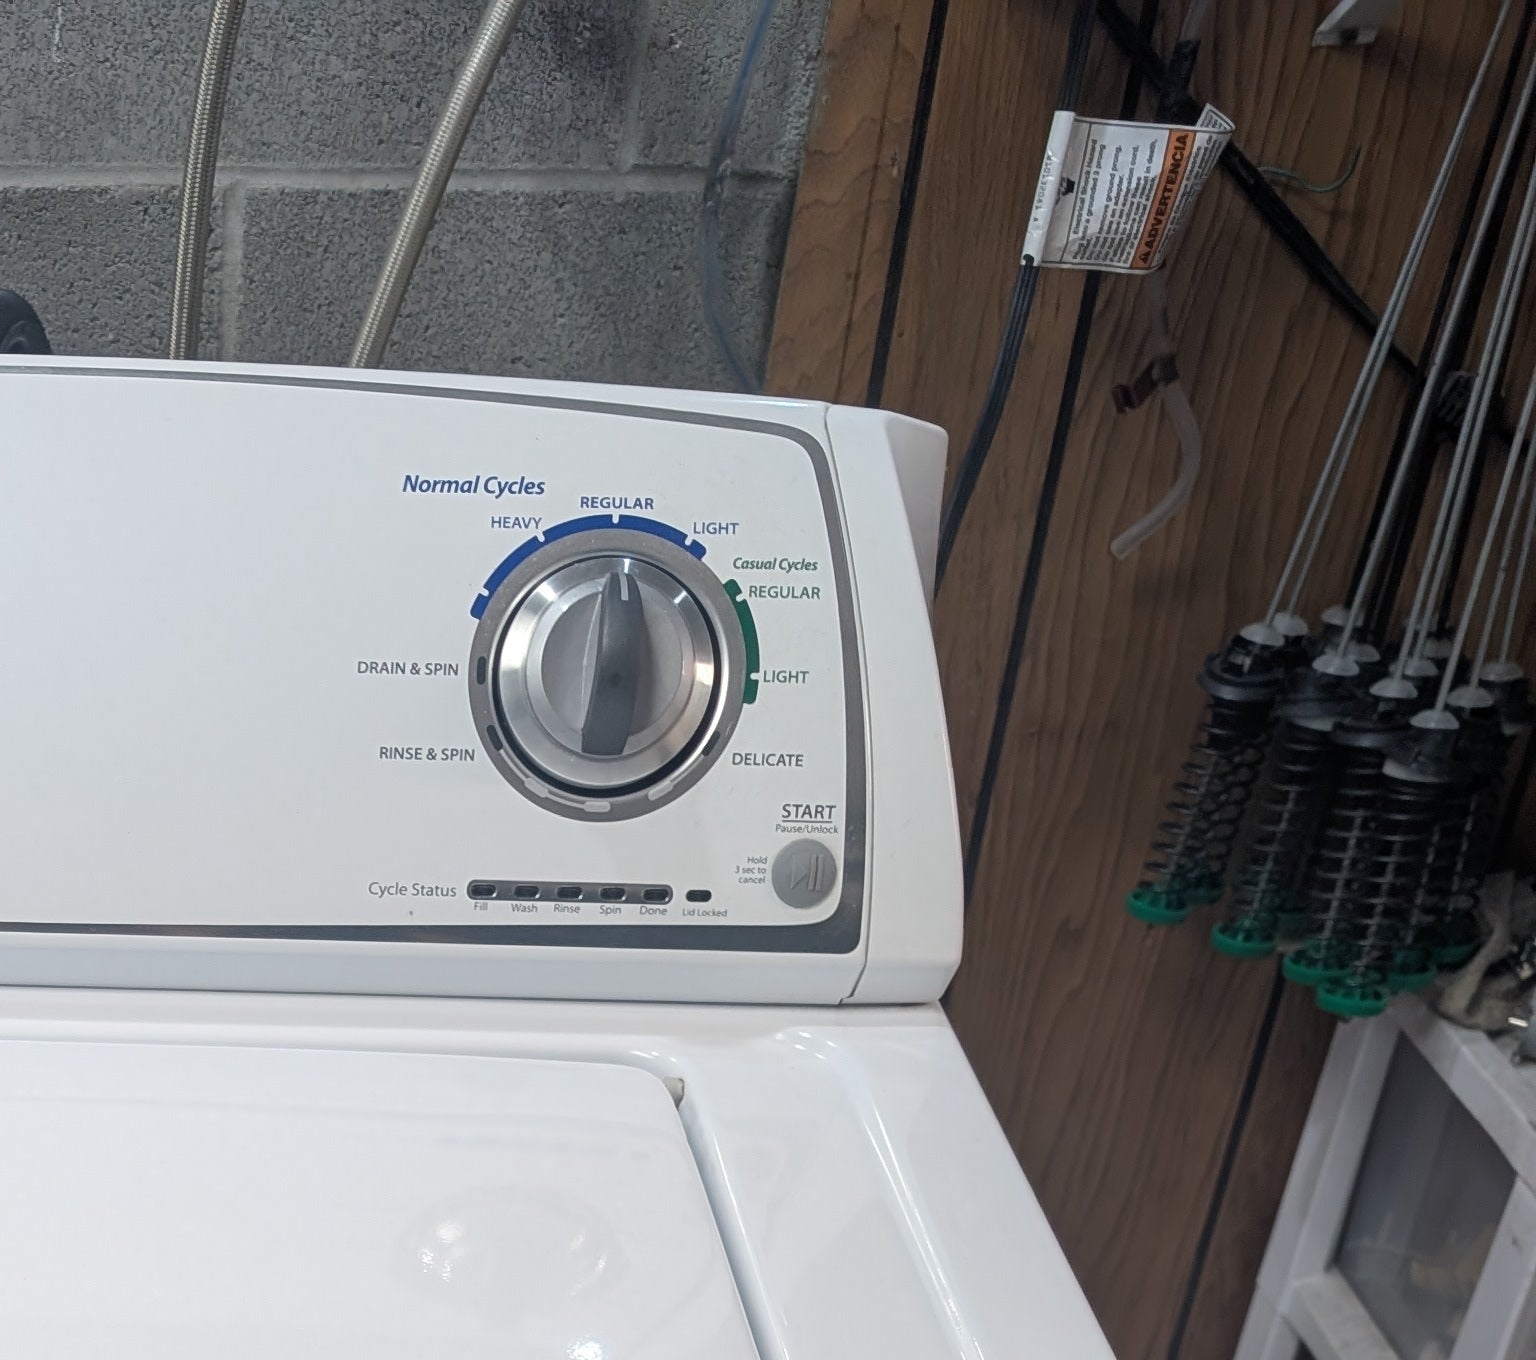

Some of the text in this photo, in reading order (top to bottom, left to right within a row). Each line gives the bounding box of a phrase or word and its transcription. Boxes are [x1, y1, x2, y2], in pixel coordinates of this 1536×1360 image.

[1087, 177, 1098, 217] grounded
[1096, 144, 1106, 169] prong
[1106, 173, 1115, 202] ground
[1146, 135, 1187, 248] ADVERTENCIA
[402, 475, 545, 499] Normal Cycles
[580, 496, 654, 510] REGULAR
[491, 516, 542, 529] HEAVY
[693, 522, 739, 536] LIGHT
[732, 557, 818, 573] Casual Cycles
[748, 585, 821, 600] REGULAR
[357, 660, 459, 676] DRAIN & SPIN
[763, 670, 809, 684] LIGHT
[379, 746, 475, 762] RINSE & SPIN
[731, 752, 804, 767] DELICATE
[782, 804, 837, 820] START
[775, 824, 839, 834] Pause/Unlock
[747, 856, 768, 864] Hold
[757, 866, 766, 874] to
[738, 876, 766, 884] cancel
[368, 882, 457, 898] Cycle Status
[473, 901, 488, 912] Fill
[511, 903, 538, 914] Wash
[553, 903, 581, 914] Rinse
[599, 904, 622, 916] Spin
[639, 905, 668, 916] Done
[682, 908, 728, 918] Lid Locked
